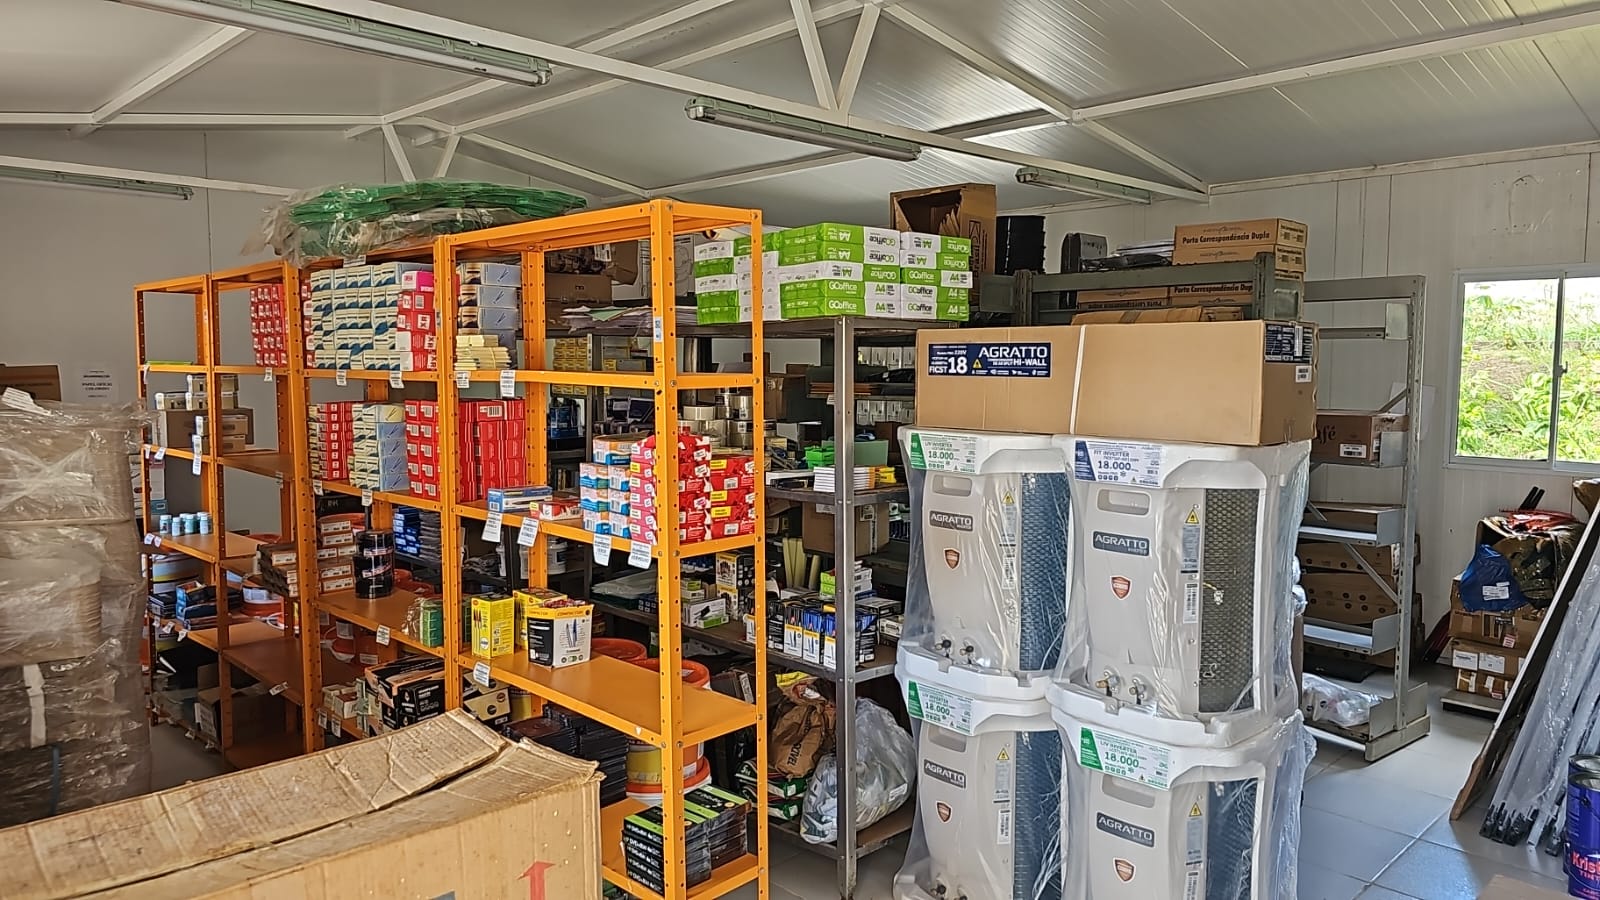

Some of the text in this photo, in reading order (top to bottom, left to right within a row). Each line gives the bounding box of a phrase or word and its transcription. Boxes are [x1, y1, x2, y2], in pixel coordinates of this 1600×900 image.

[979, 346, 1048, 358] AGRATTO
[948, 356, 968, 374] 18
[928, 450, 955, 460] 18.000
[1098, 460, 1132, 471] 18.000
[930, 513, 972, 526] AGRATTO
[1094, 534, 1148, 549] AGRATTO
[925, 702, 951, 716] 18.000
[1104, 751, 1140, 768] 18.000
[925, 762, 965, 783] AGRATTO
[1098, 816, 1153, 841] AGRATTO
